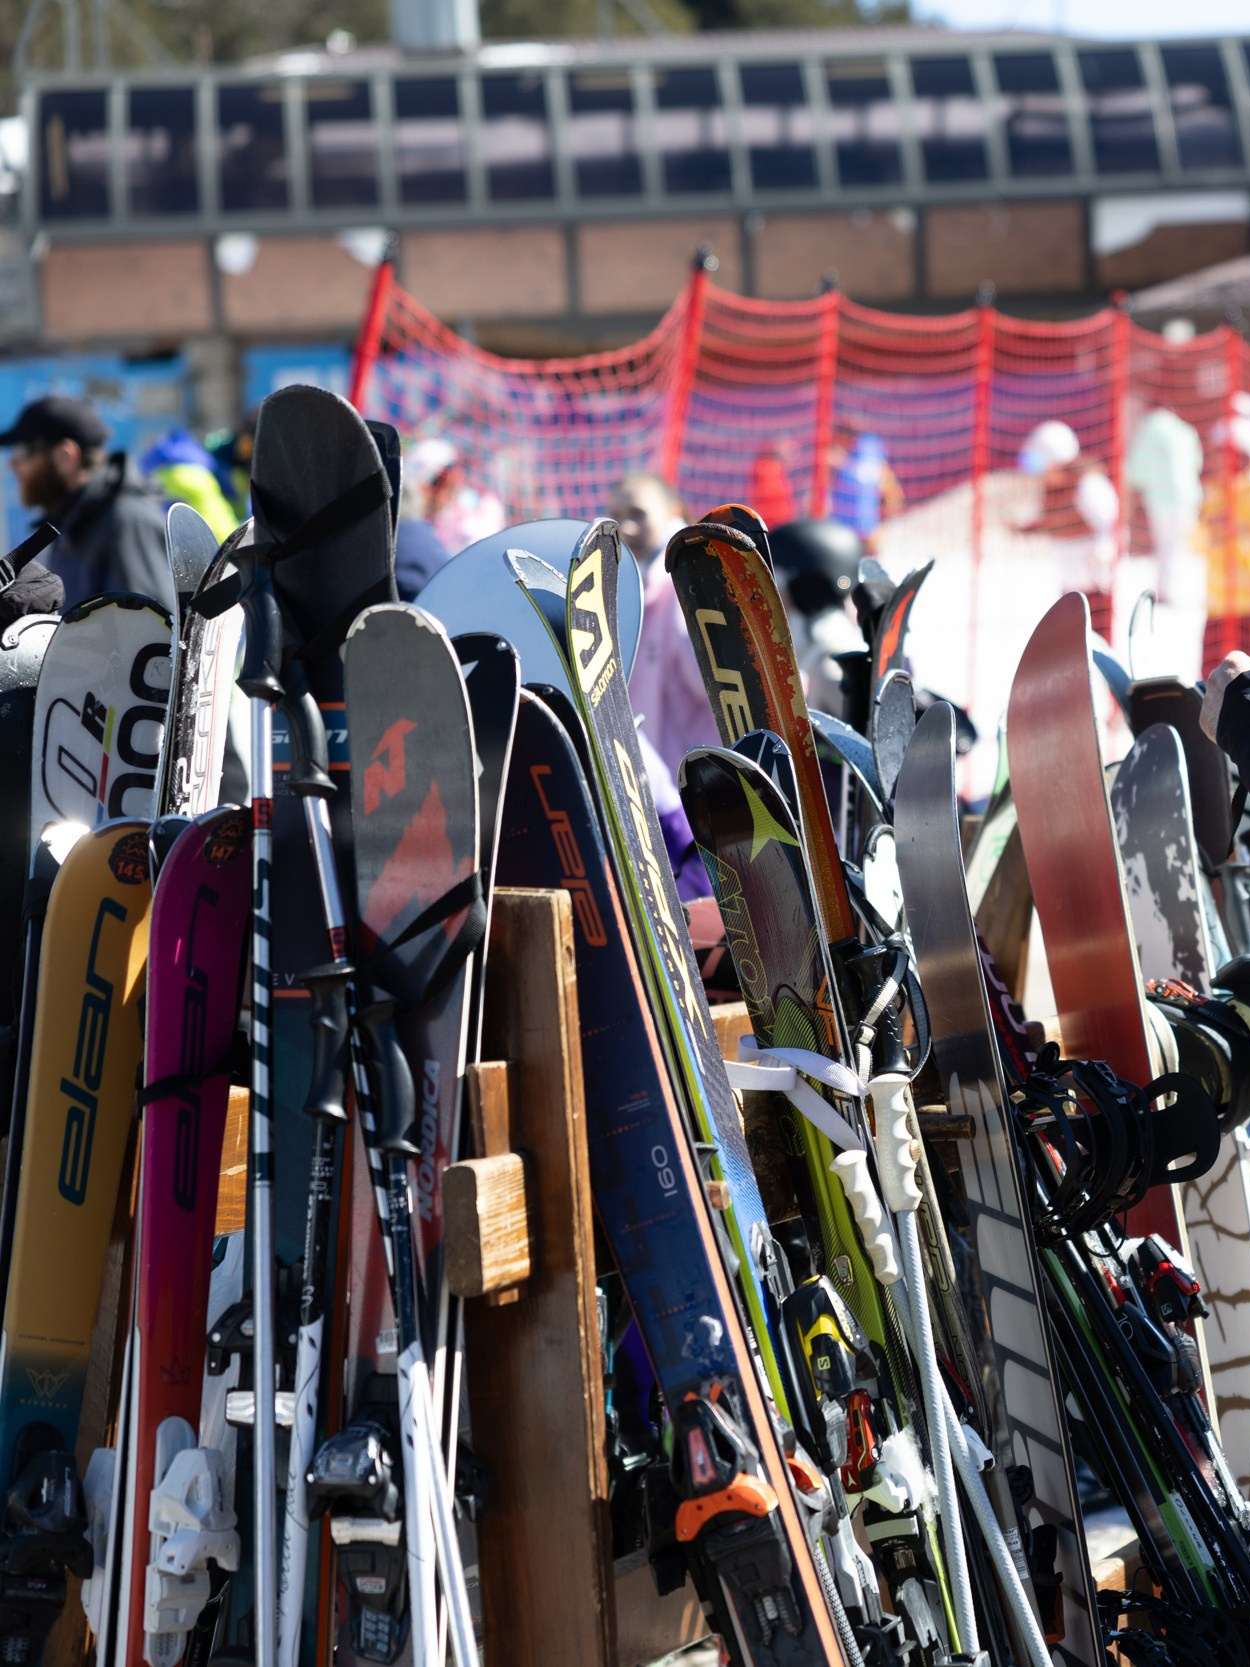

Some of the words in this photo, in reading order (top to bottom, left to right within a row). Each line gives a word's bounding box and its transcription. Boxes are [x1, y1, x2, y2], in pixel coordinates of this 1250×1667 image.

[117, 861, 144, 879] 145
[210, 845, 234, 860] 147
[530, 765, 608, 947] elan
[58, 896, 128, 1207] elan
[420, 1060, 441, 1223] NORDICA
[651, 1145, 678, 1198] 160
